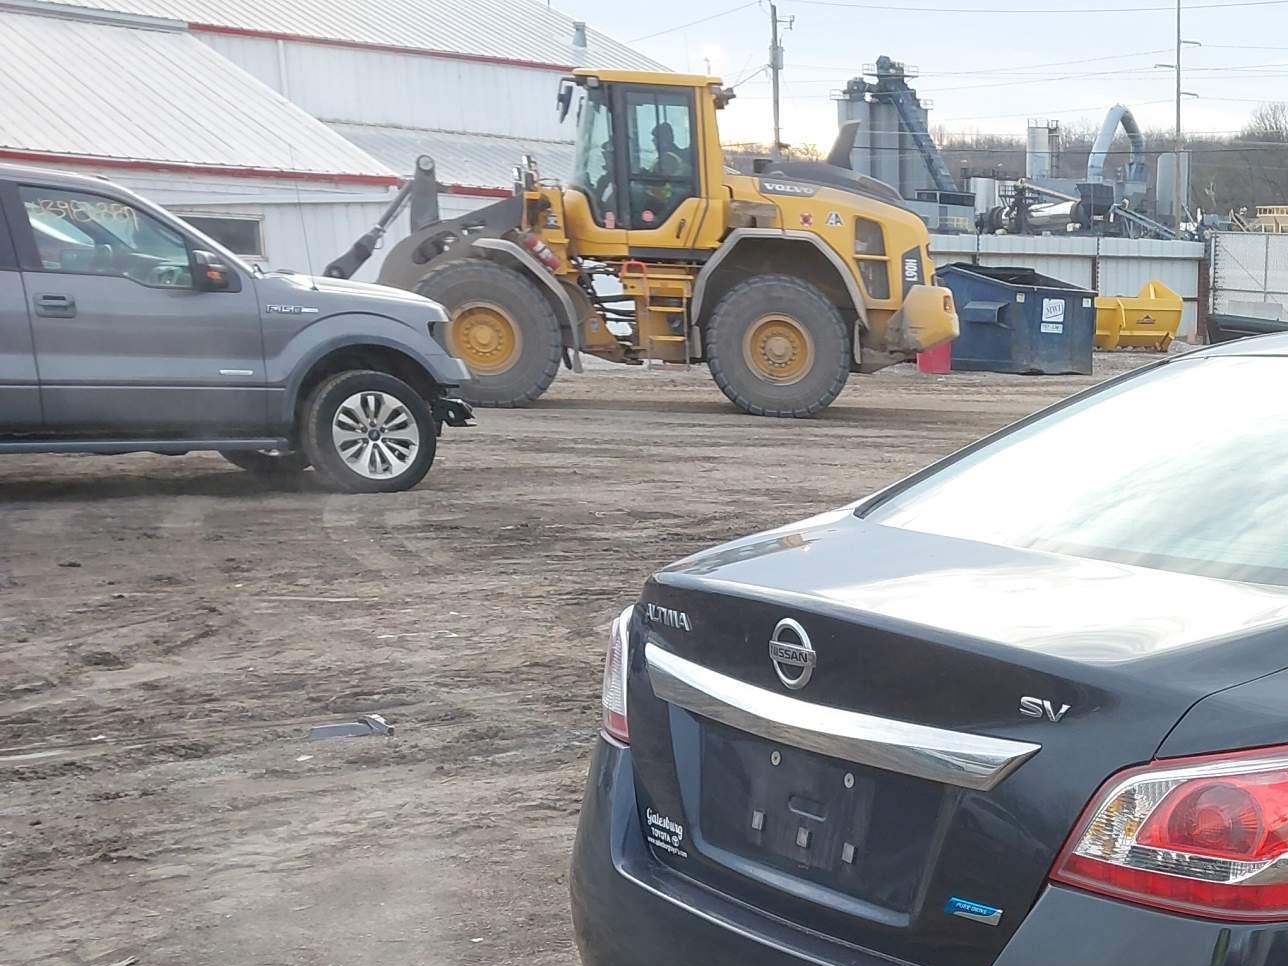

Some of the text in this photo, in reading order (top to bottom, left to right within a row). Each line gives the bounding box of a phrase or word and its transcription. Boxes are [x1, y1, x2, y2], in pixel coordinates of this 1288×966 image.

[764, 182, 816, 194] VOLVO
[905, 258, 919, 282] L90H
[645, 602, 693, 632] ALTIMA
[770, 644, 808, 663] NISSAN
[1019, 696, 1071, 722] SV
[646, 807, 683, 841] Galesburg
[651, 826, 672, 843] TOYOTA
